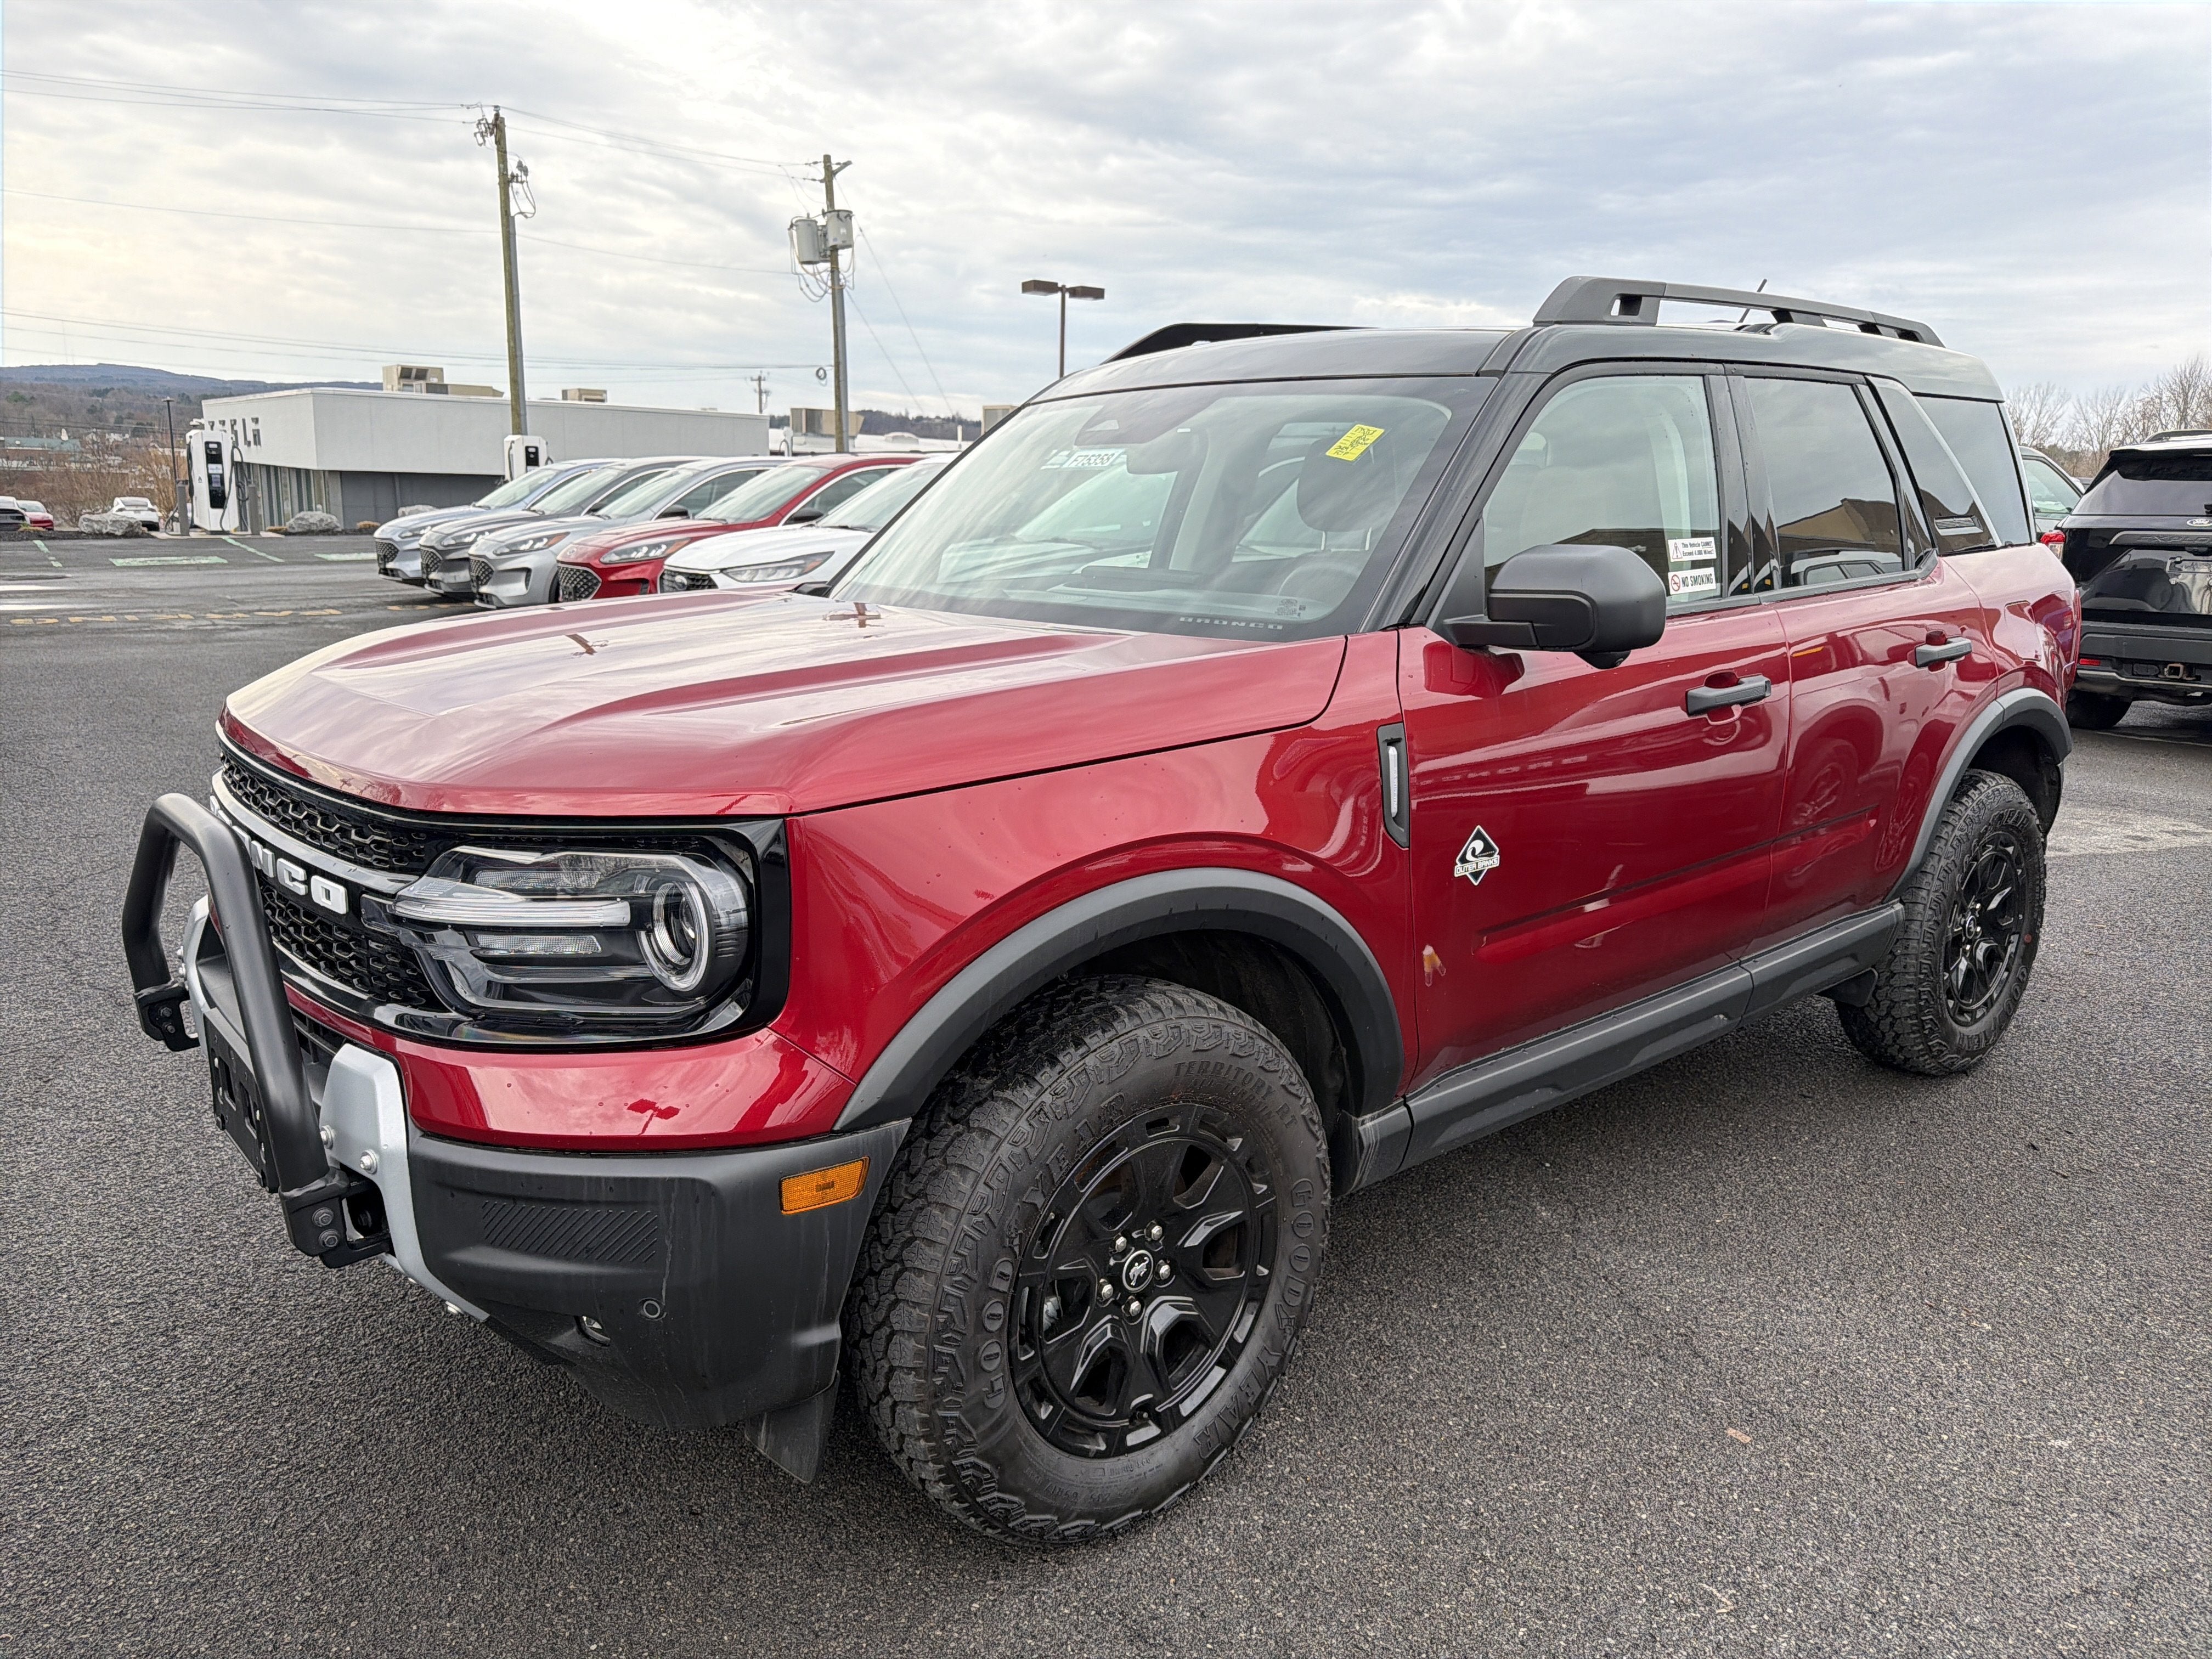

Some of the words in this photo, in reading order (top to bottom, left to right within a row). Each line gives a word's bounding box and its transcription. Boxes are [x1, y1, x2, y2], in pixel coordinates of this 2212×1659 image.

[1681, 576, 1689, 588] NO
[1690, 573, 1713, 586] SMOKING
[1180, 617, 1283, 630] BRONCO
[1457, 863, 1476, 874] OUTER
[1478, 857, 1498, 869] BANKS
[1174, 1060, 1276, 1099] TERRITORY
